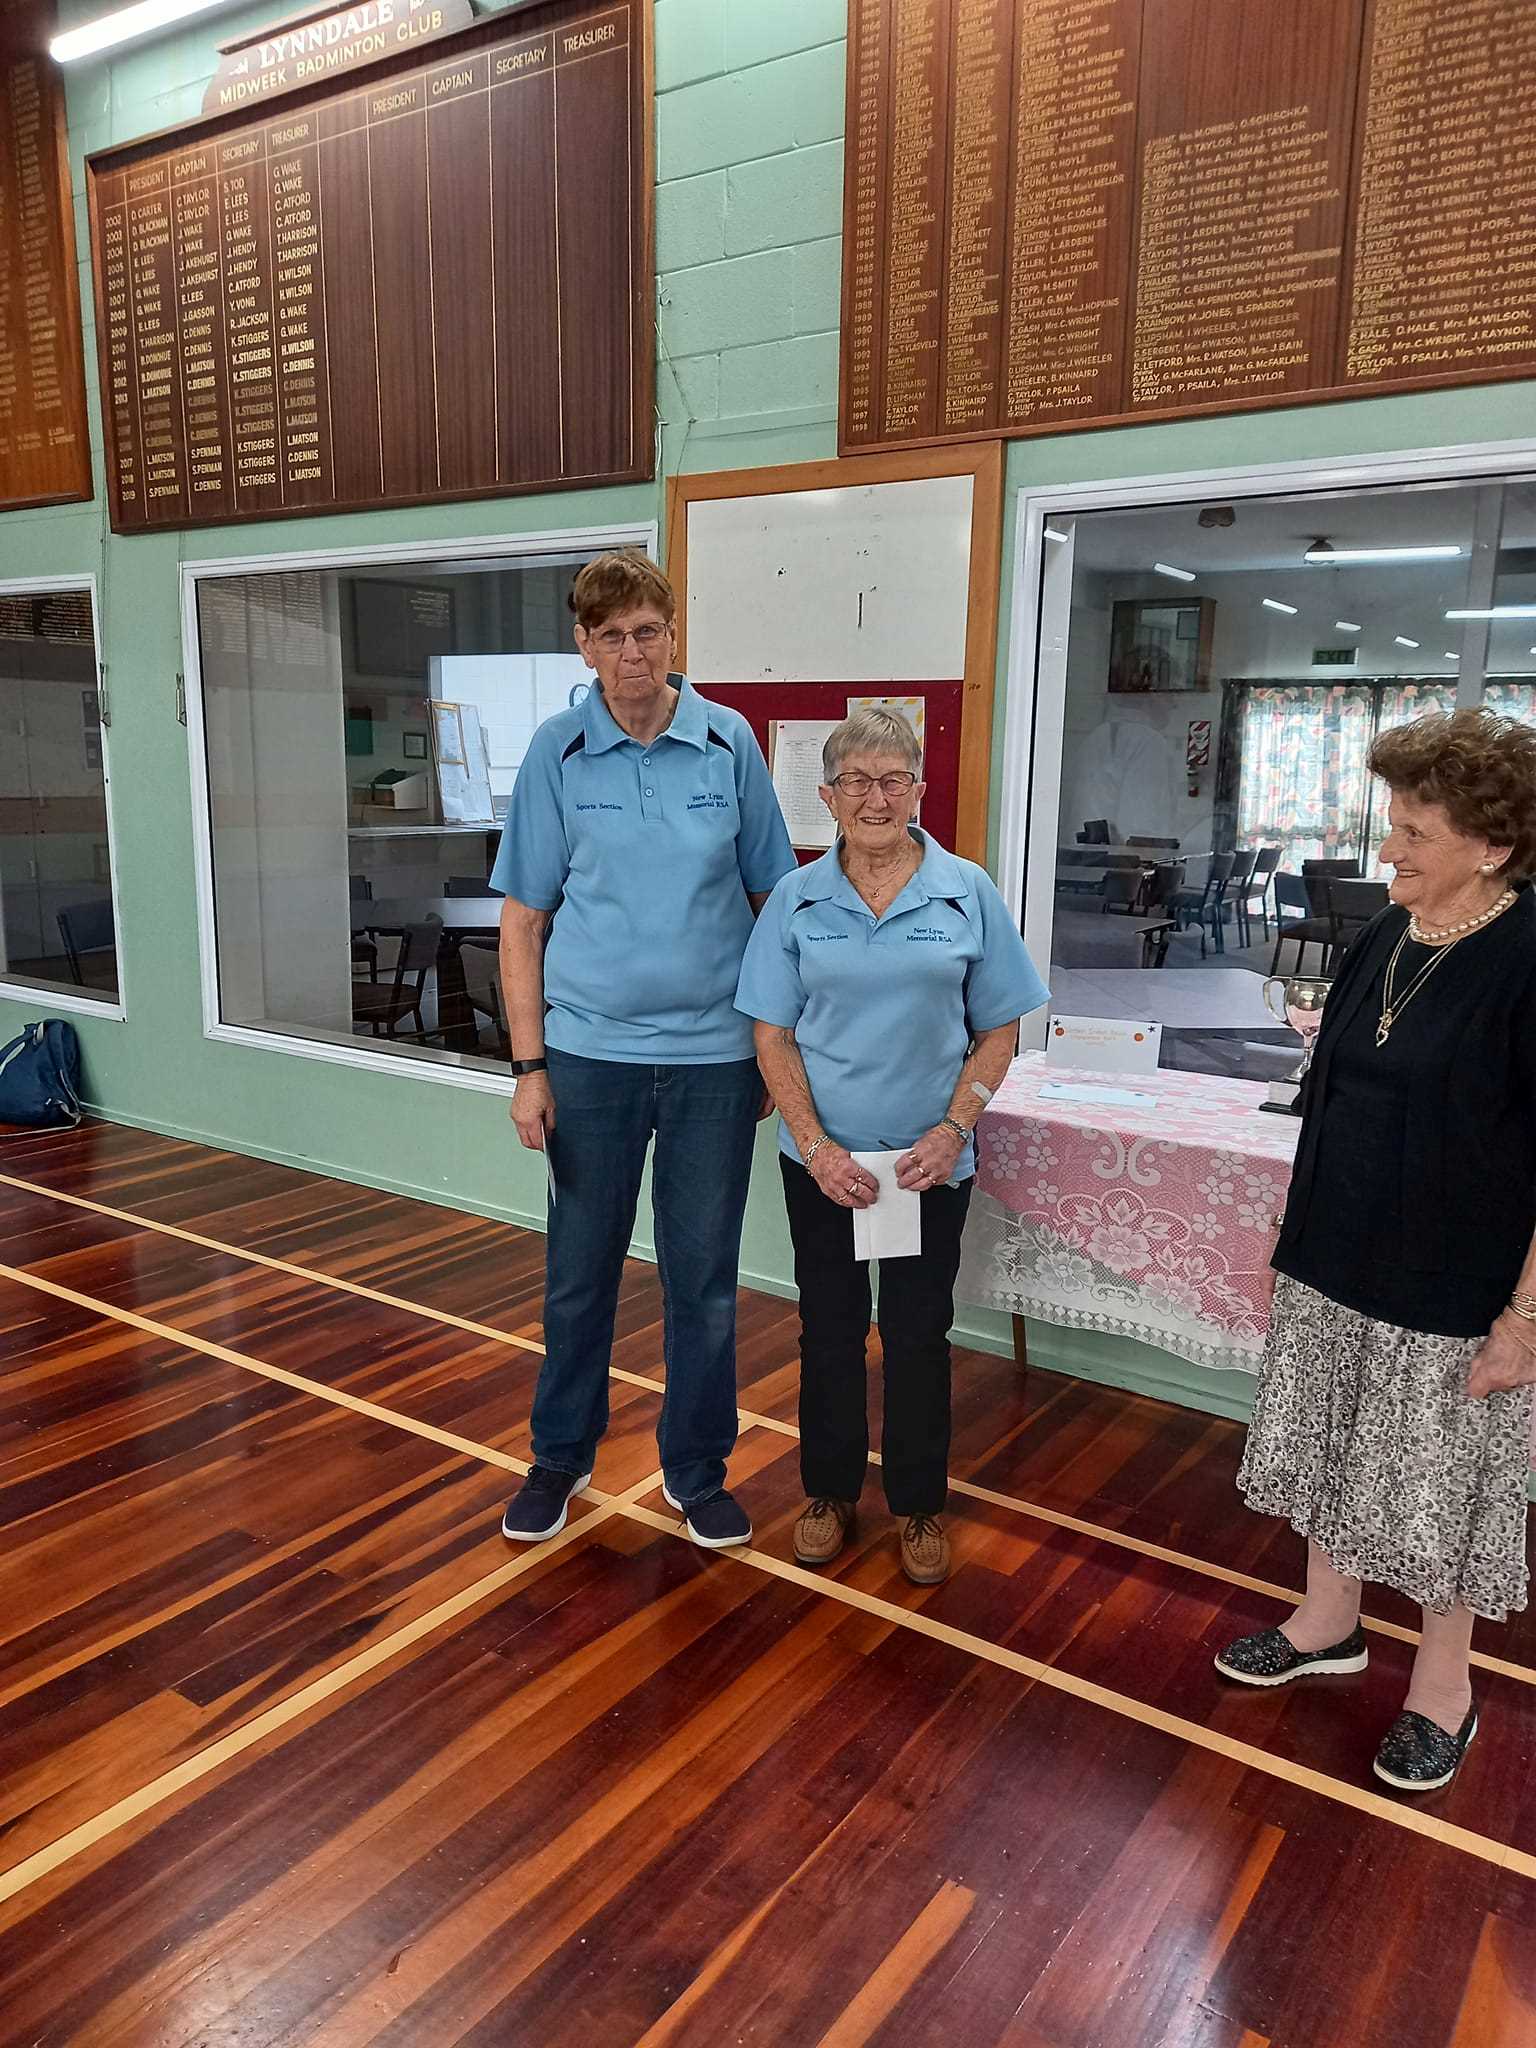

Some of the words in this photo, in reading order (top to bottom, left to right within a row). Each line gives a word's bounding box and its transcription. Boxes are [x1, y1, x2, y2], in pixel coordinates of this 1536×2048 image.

[257, 1, 394, 68] LYNNDALE
[220, 69, 287, 105] MIDWEEK
[297, 32, 385, 78] BADMINTON
[396, 10, 443, 42] CLUB
[129, 171, 164, 191] PRESIDENT
[174, 157, 206, 177] CAPTAIN
[222, 141, 259, 162] SECRETARY
[271, 124, 310, 146] TREASURER
[372, 89, 417, 115] PRESIDENT
[432, 70, 473, 95] CAPTAIN
[496, 47, 547, 75] SECRETARY
[563, 24, 615, 54] TREASURER
[105, 214, 121, 228] 2002
[106, 230, 122, 244] 2003
[113, 359, 126, 372] 2011
[1316, 650, 1352, 662] EXIT
[692, 794, 706, 802] New
[576, 803, 597, 811] Sports
[599, 803, 623, 811] Section
[716, 801, 729, 809] RSA
[929, 927, 945, 936] Lynn
[826, 934, 849, 942] Section
[938, 935, 952, 943] RSA
